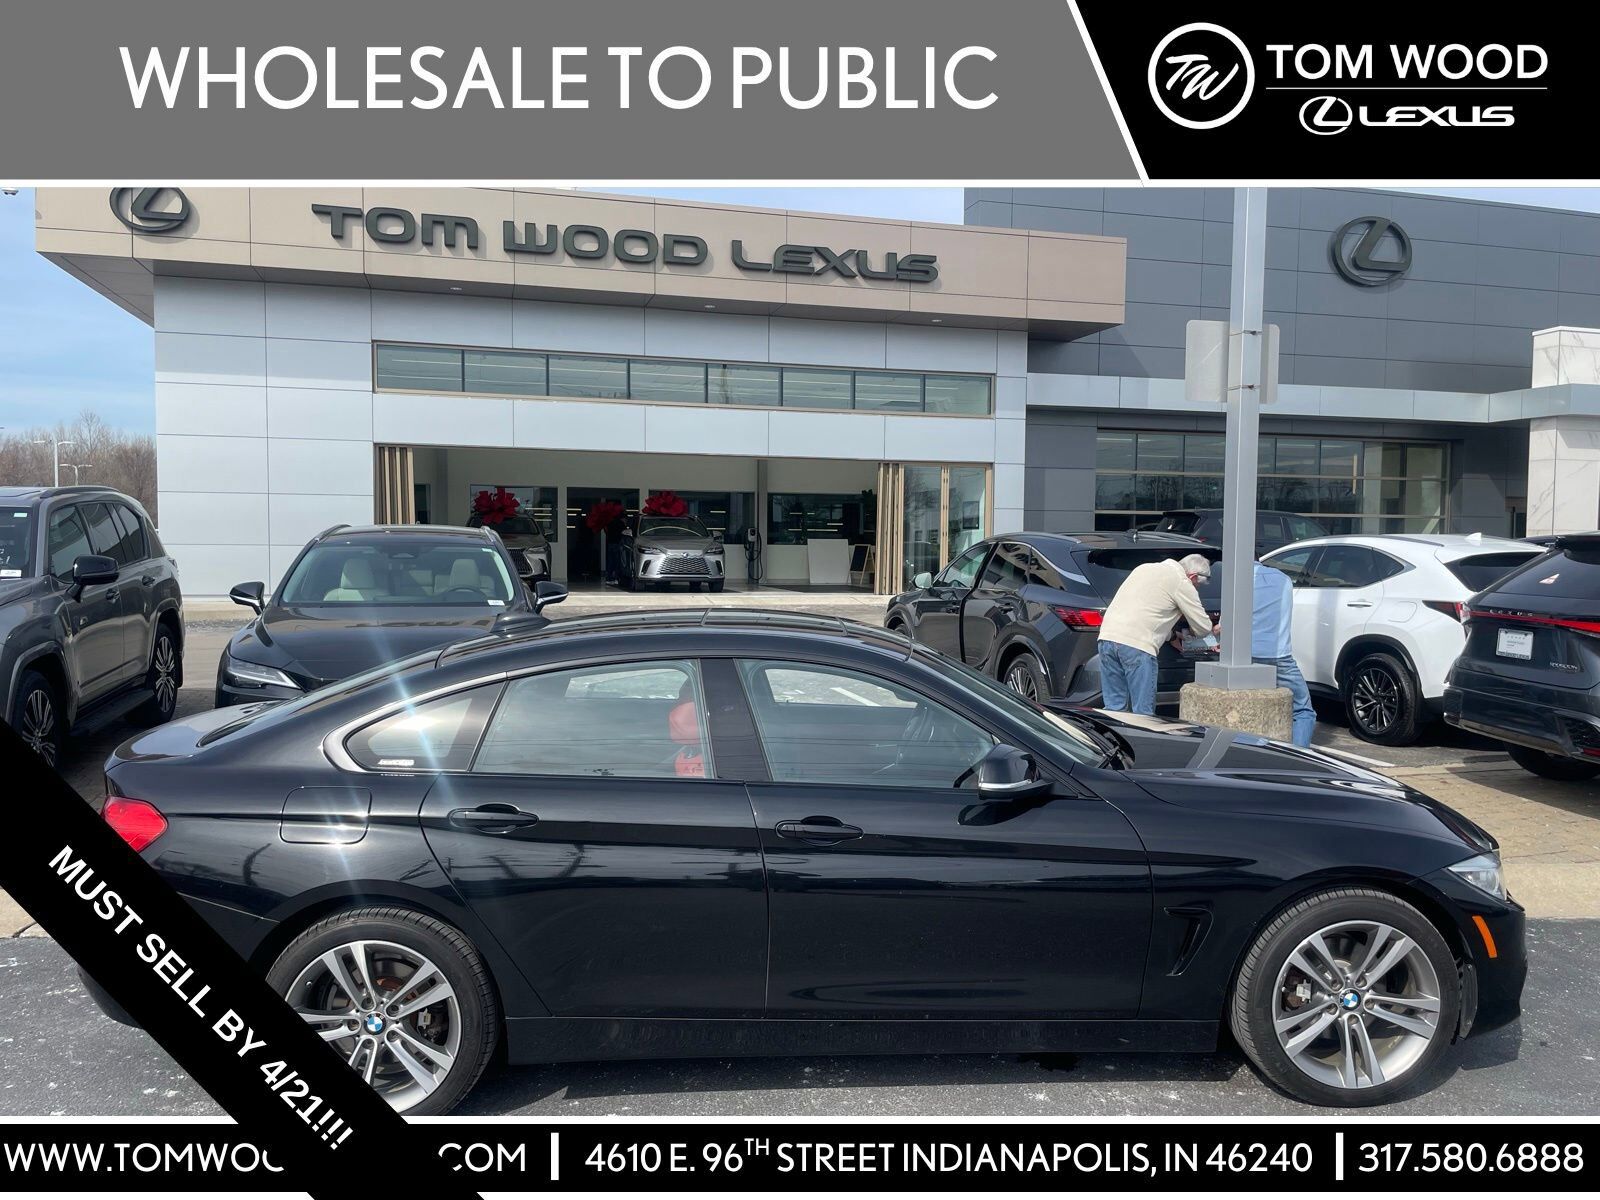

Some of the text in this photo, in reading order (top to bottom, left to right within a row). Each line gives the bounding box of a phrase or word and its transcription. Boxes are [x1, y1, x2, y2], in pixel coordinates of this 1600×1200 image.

[311, 203, 939, 283] TOM WOOD LEXUS
